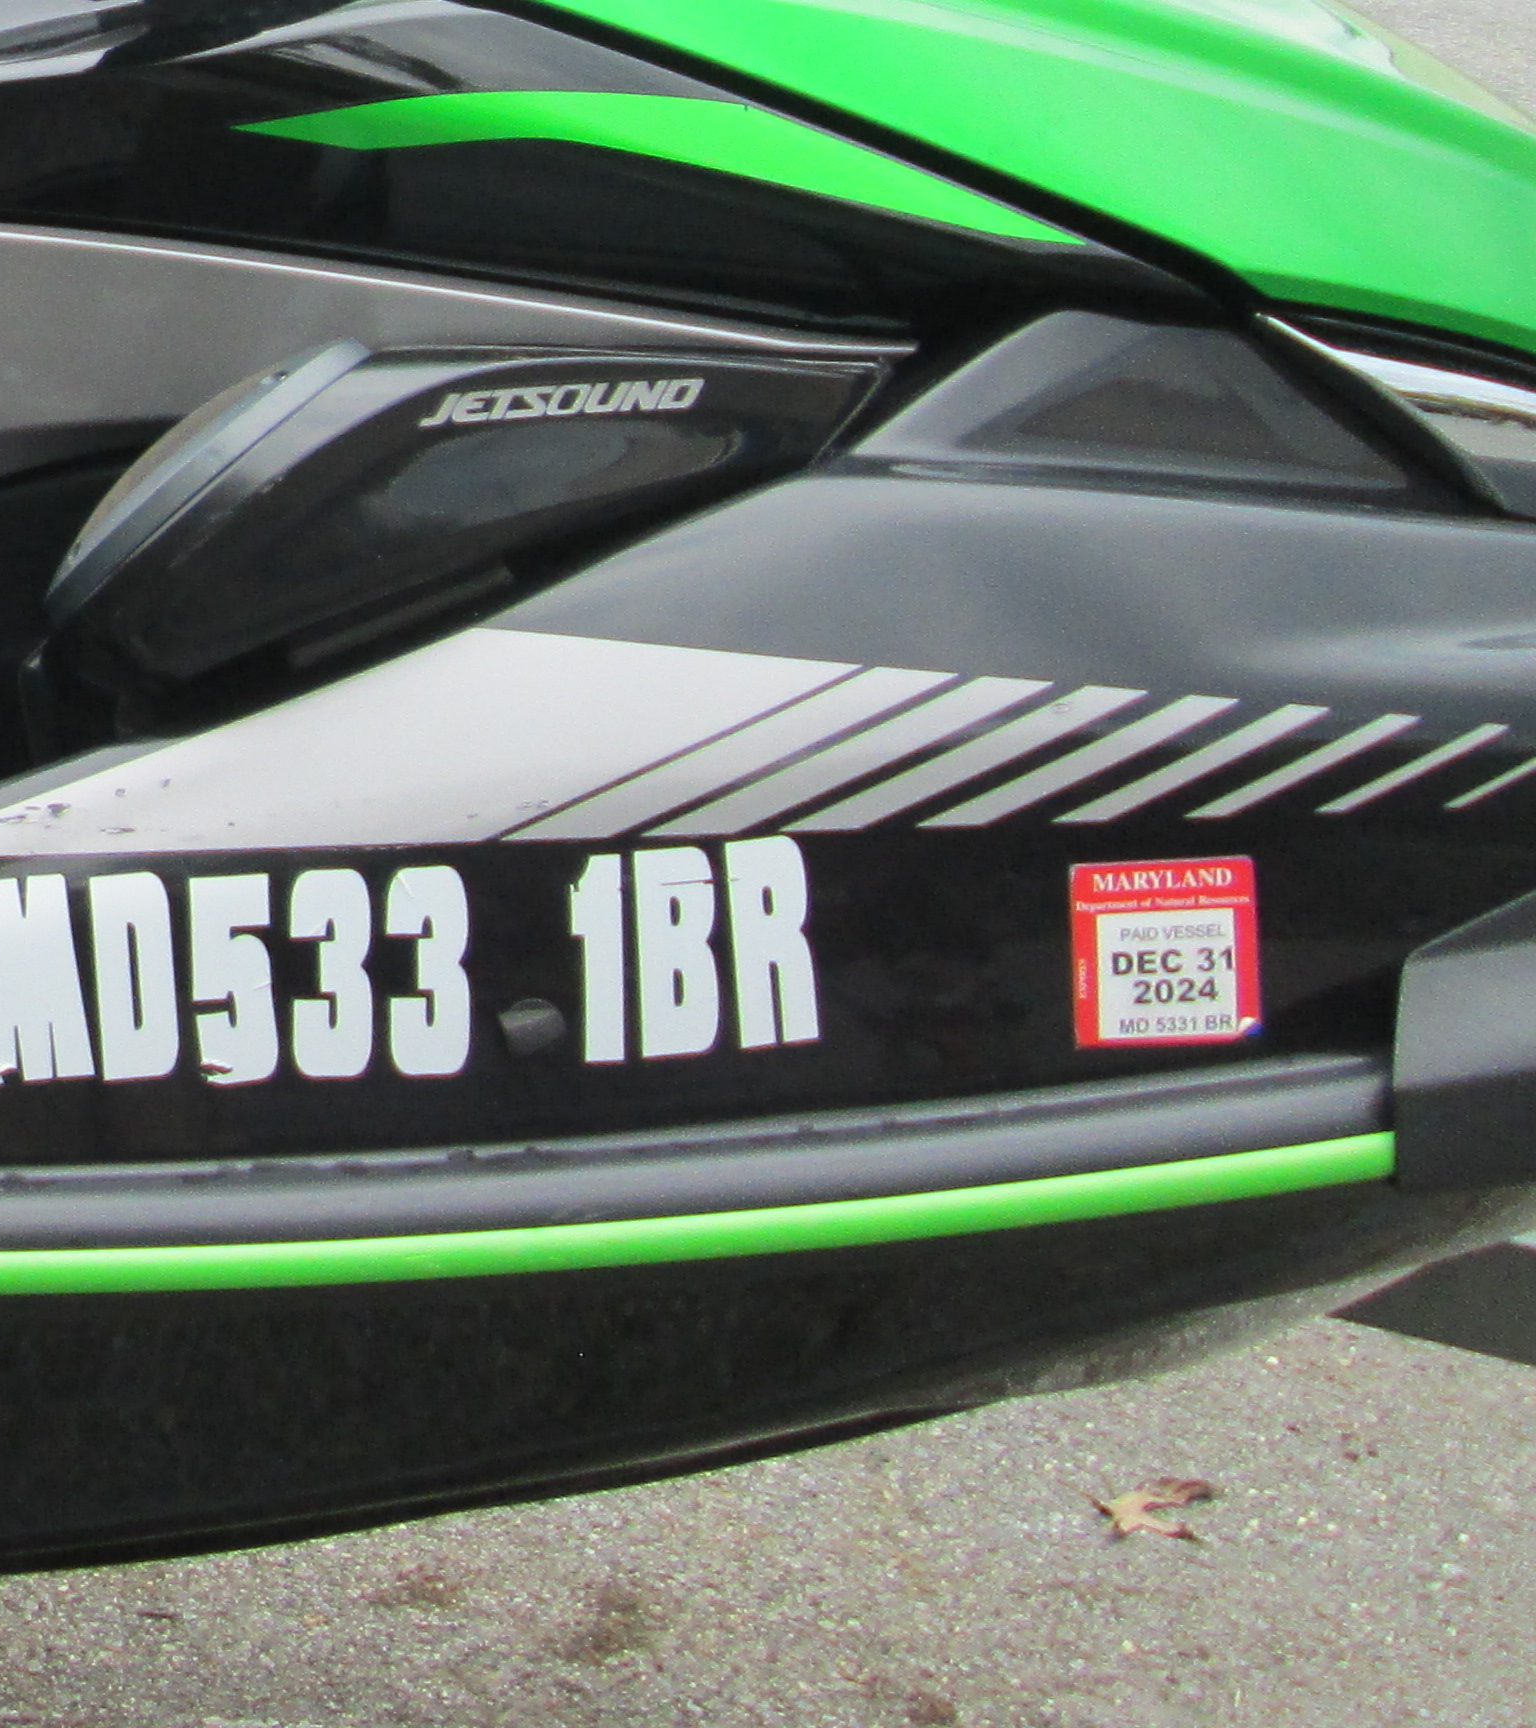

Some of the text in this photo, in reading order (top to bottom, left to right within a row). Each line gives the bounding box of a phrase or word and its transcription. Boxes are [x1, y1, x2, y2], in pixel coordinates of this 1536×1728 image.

[418, 377, 705, 429] JETSOUND
[1092, 867, 1233, 893] MARYLAND
[1120, 923, 1226, 942] PAID VESSEL
[570, 835, 821, 1063] 1BR
[1111, 945, 1234, 976] DEC 31
[1132, 976, 1219, 1005] 2024
[1118, 1014, 1234, 1034] MD 5331 BR
